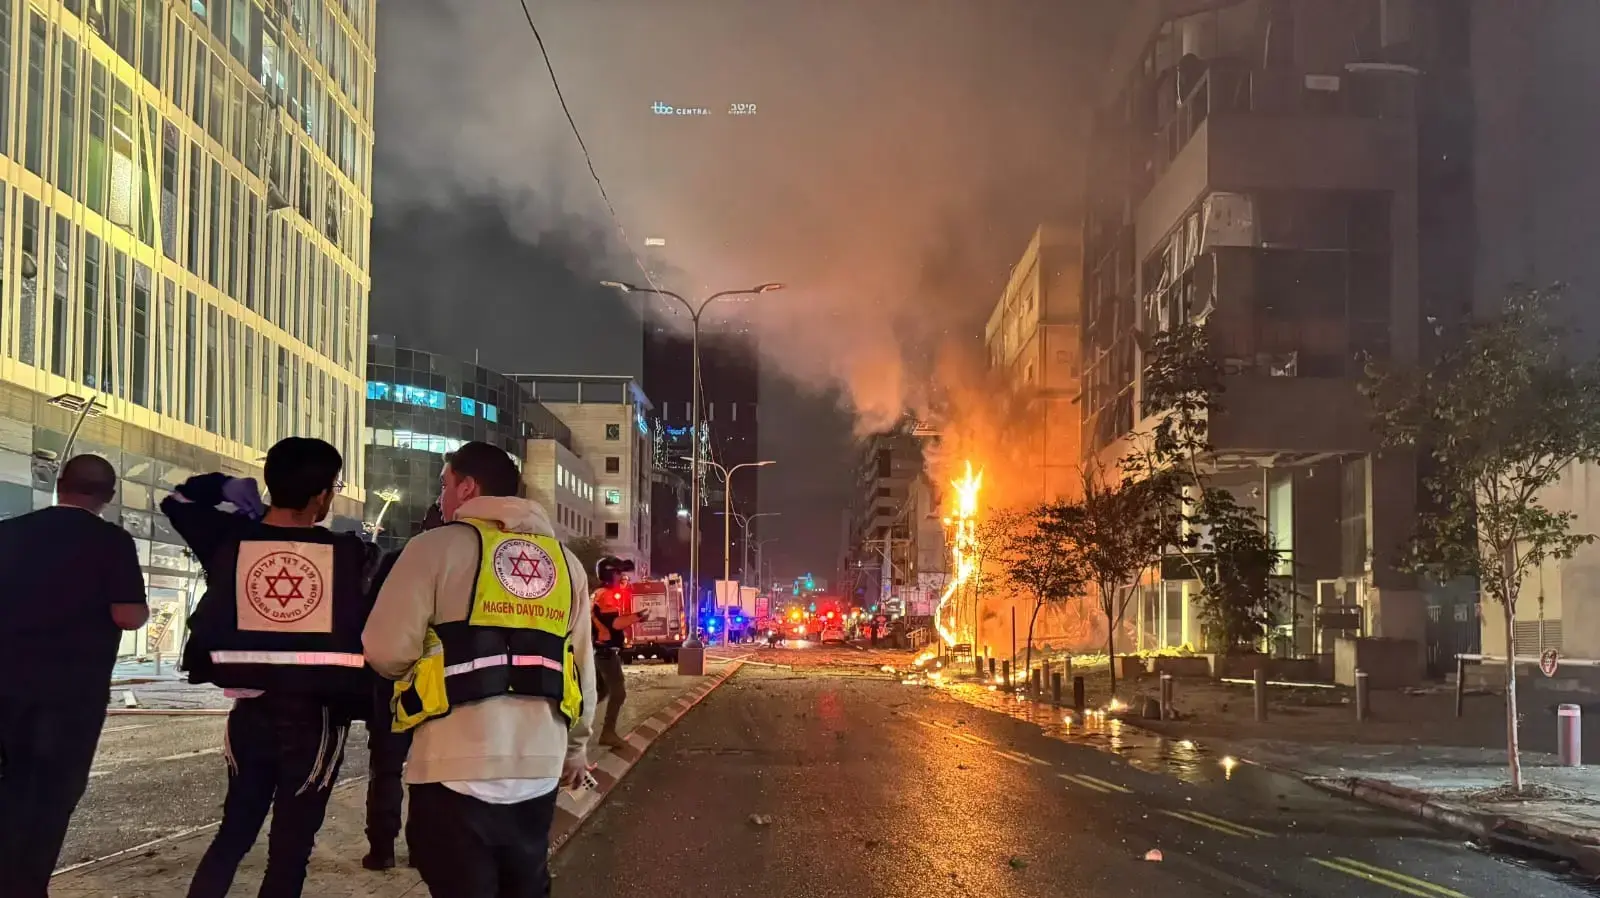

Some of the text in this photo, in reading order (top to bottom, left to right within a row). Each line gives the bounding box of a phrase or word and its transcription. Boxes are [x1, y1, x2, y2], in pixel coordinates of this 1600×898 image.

[650, 100, 673, 115] tbc
[730, 103, 757, 111] מיטב
[253, 557, 316, 578] מגן דוד אדום
[251, 584, 318, 618] MAGEN DAVID ADOM
[483, 600, 515, 614] MAGEN
[516, 603, 545, 617] DAVID
